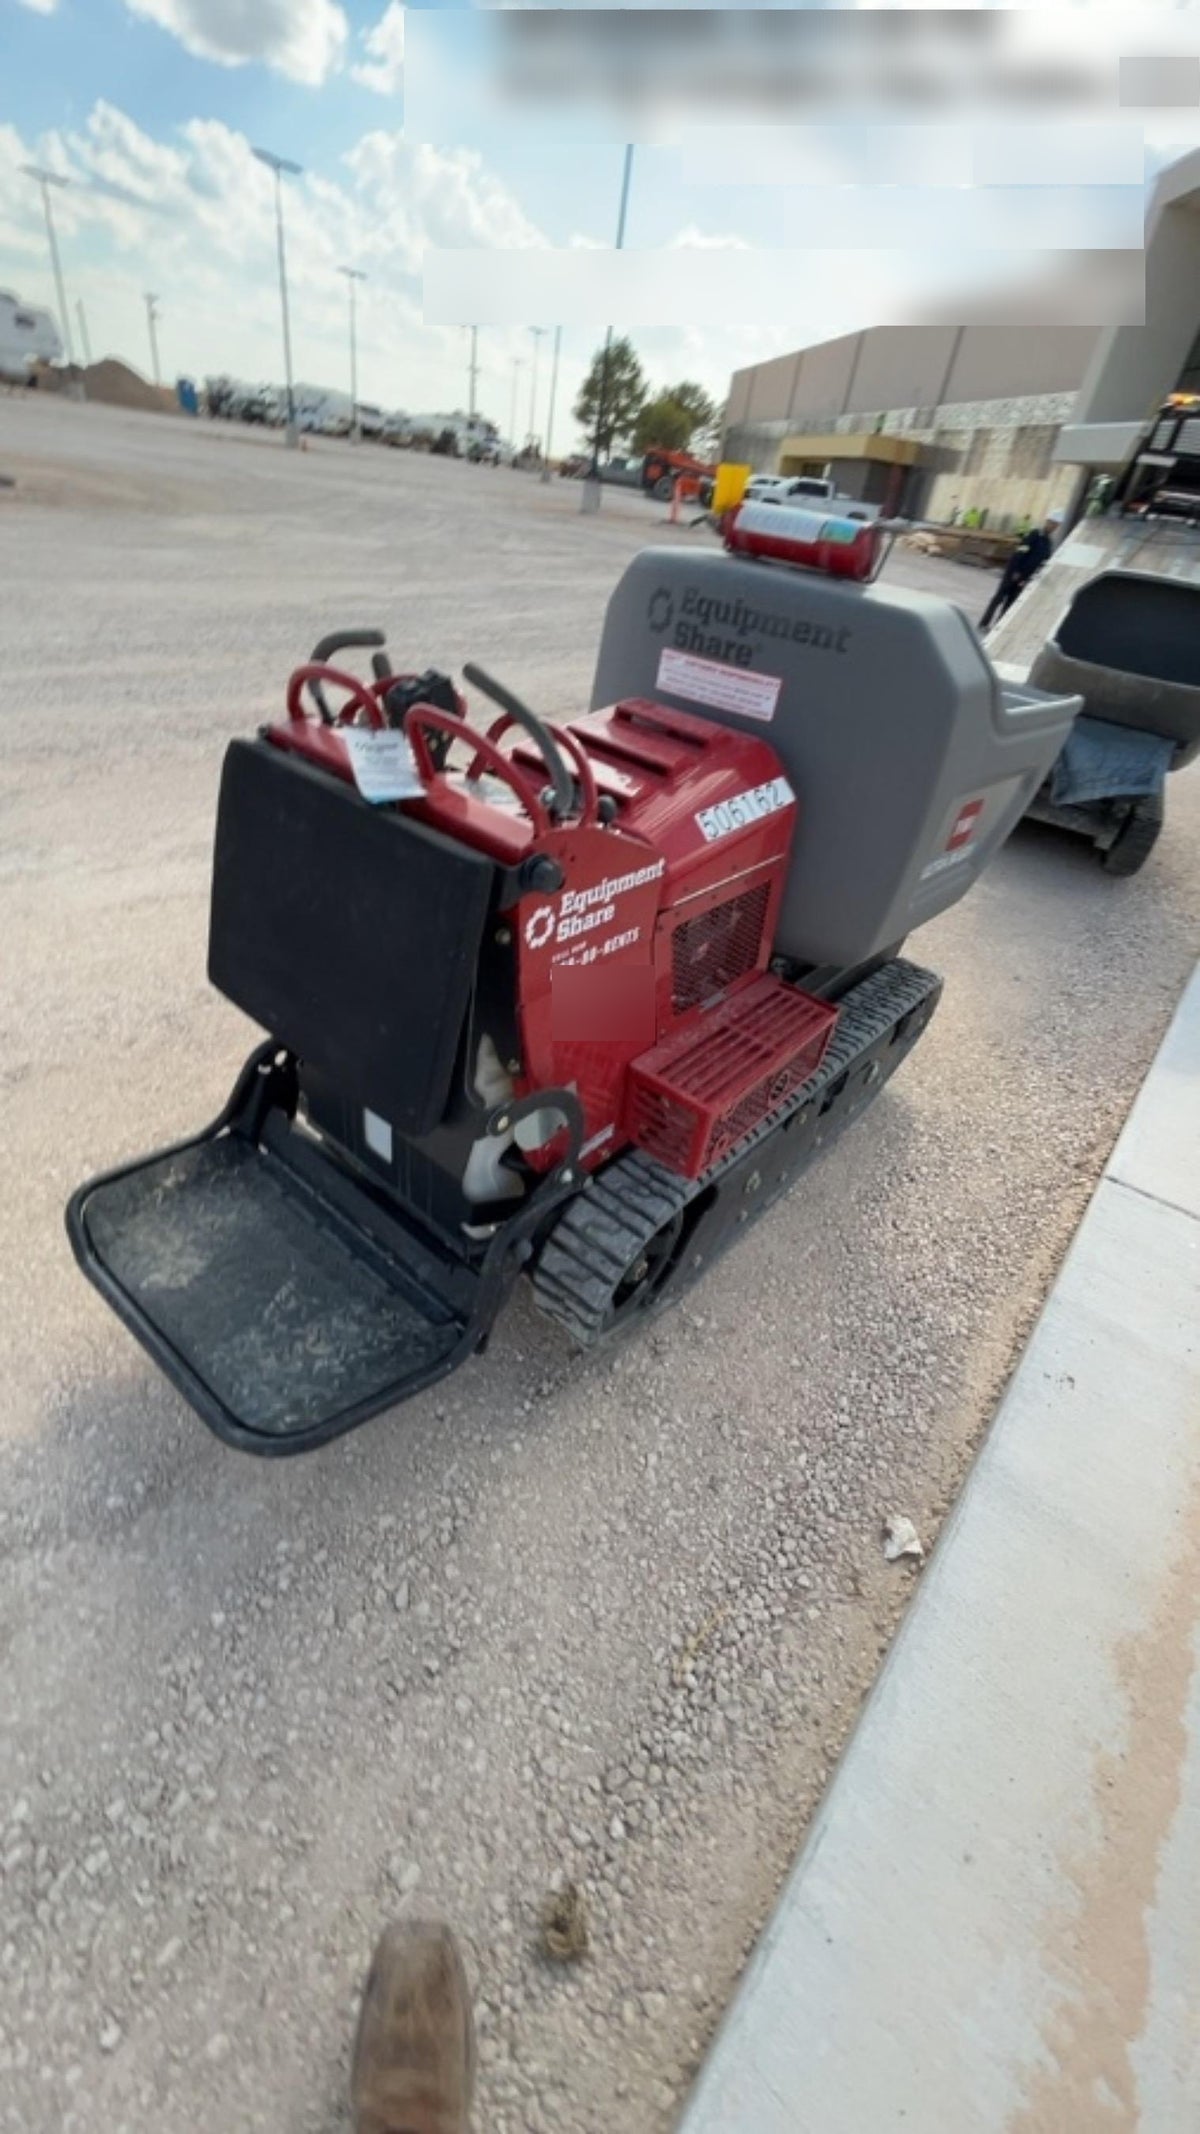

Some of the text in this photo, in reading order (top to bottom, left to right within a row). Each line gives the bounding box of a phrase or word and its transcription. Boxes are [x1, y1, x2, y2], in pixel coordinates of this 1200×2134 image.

[674, 621, 753, 667] Share
[679, 586, 853, 652] Equipment
[699, 783, 784, 838] 506162
[559, 858, 665, 917] Equipment
[556, 904, 615, 942] Share
